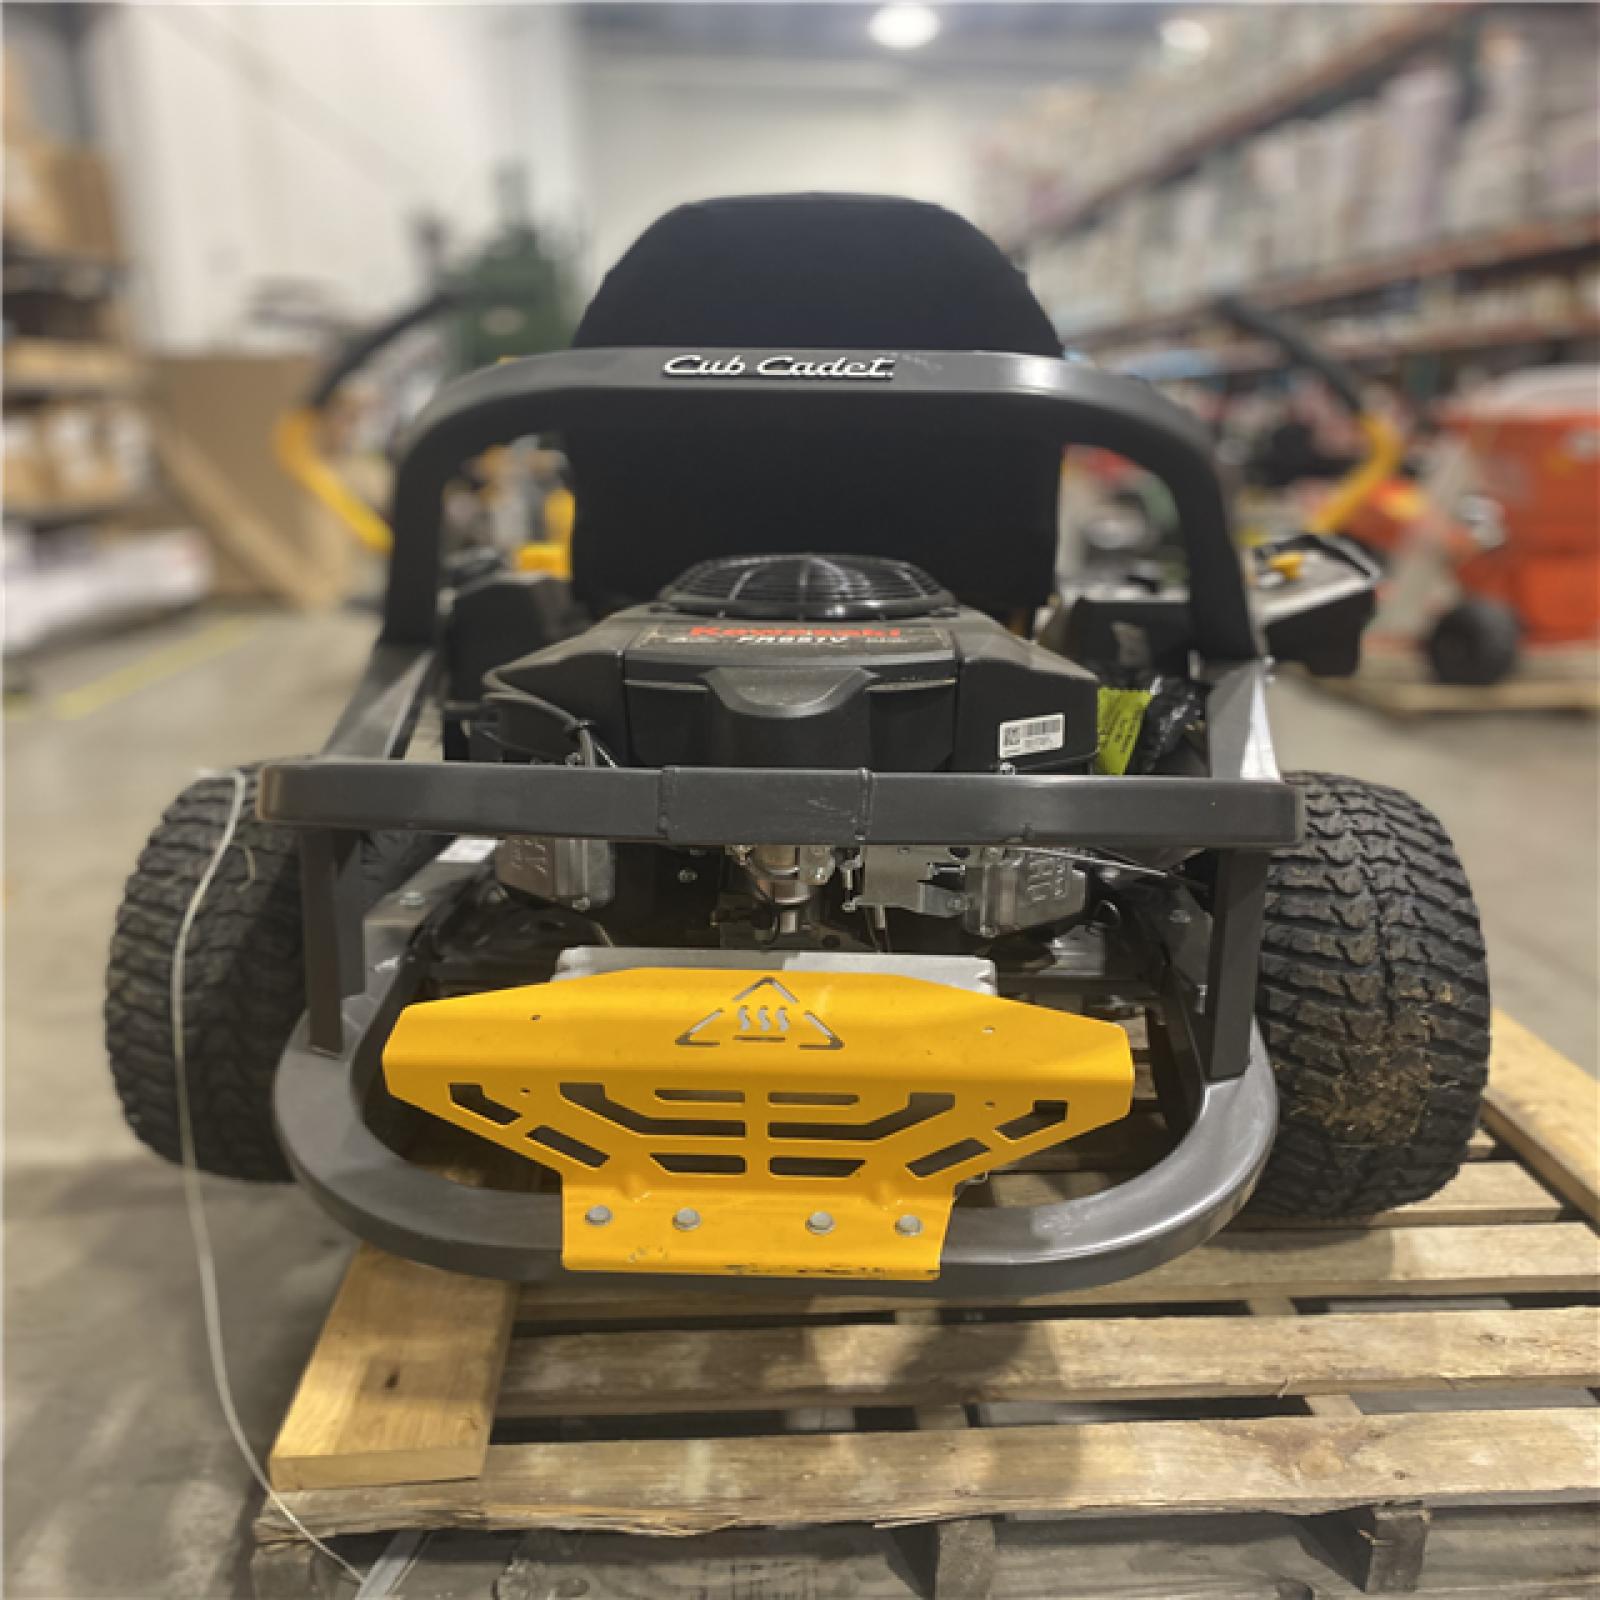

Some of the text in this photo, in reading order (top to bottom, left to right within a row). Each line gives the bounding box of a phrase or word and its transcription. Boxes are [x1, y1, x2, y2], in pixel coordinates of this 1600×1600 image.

[663, 355, 896, 378] Cub Cadet
[690, 626, 900, 637] Kawasaki
